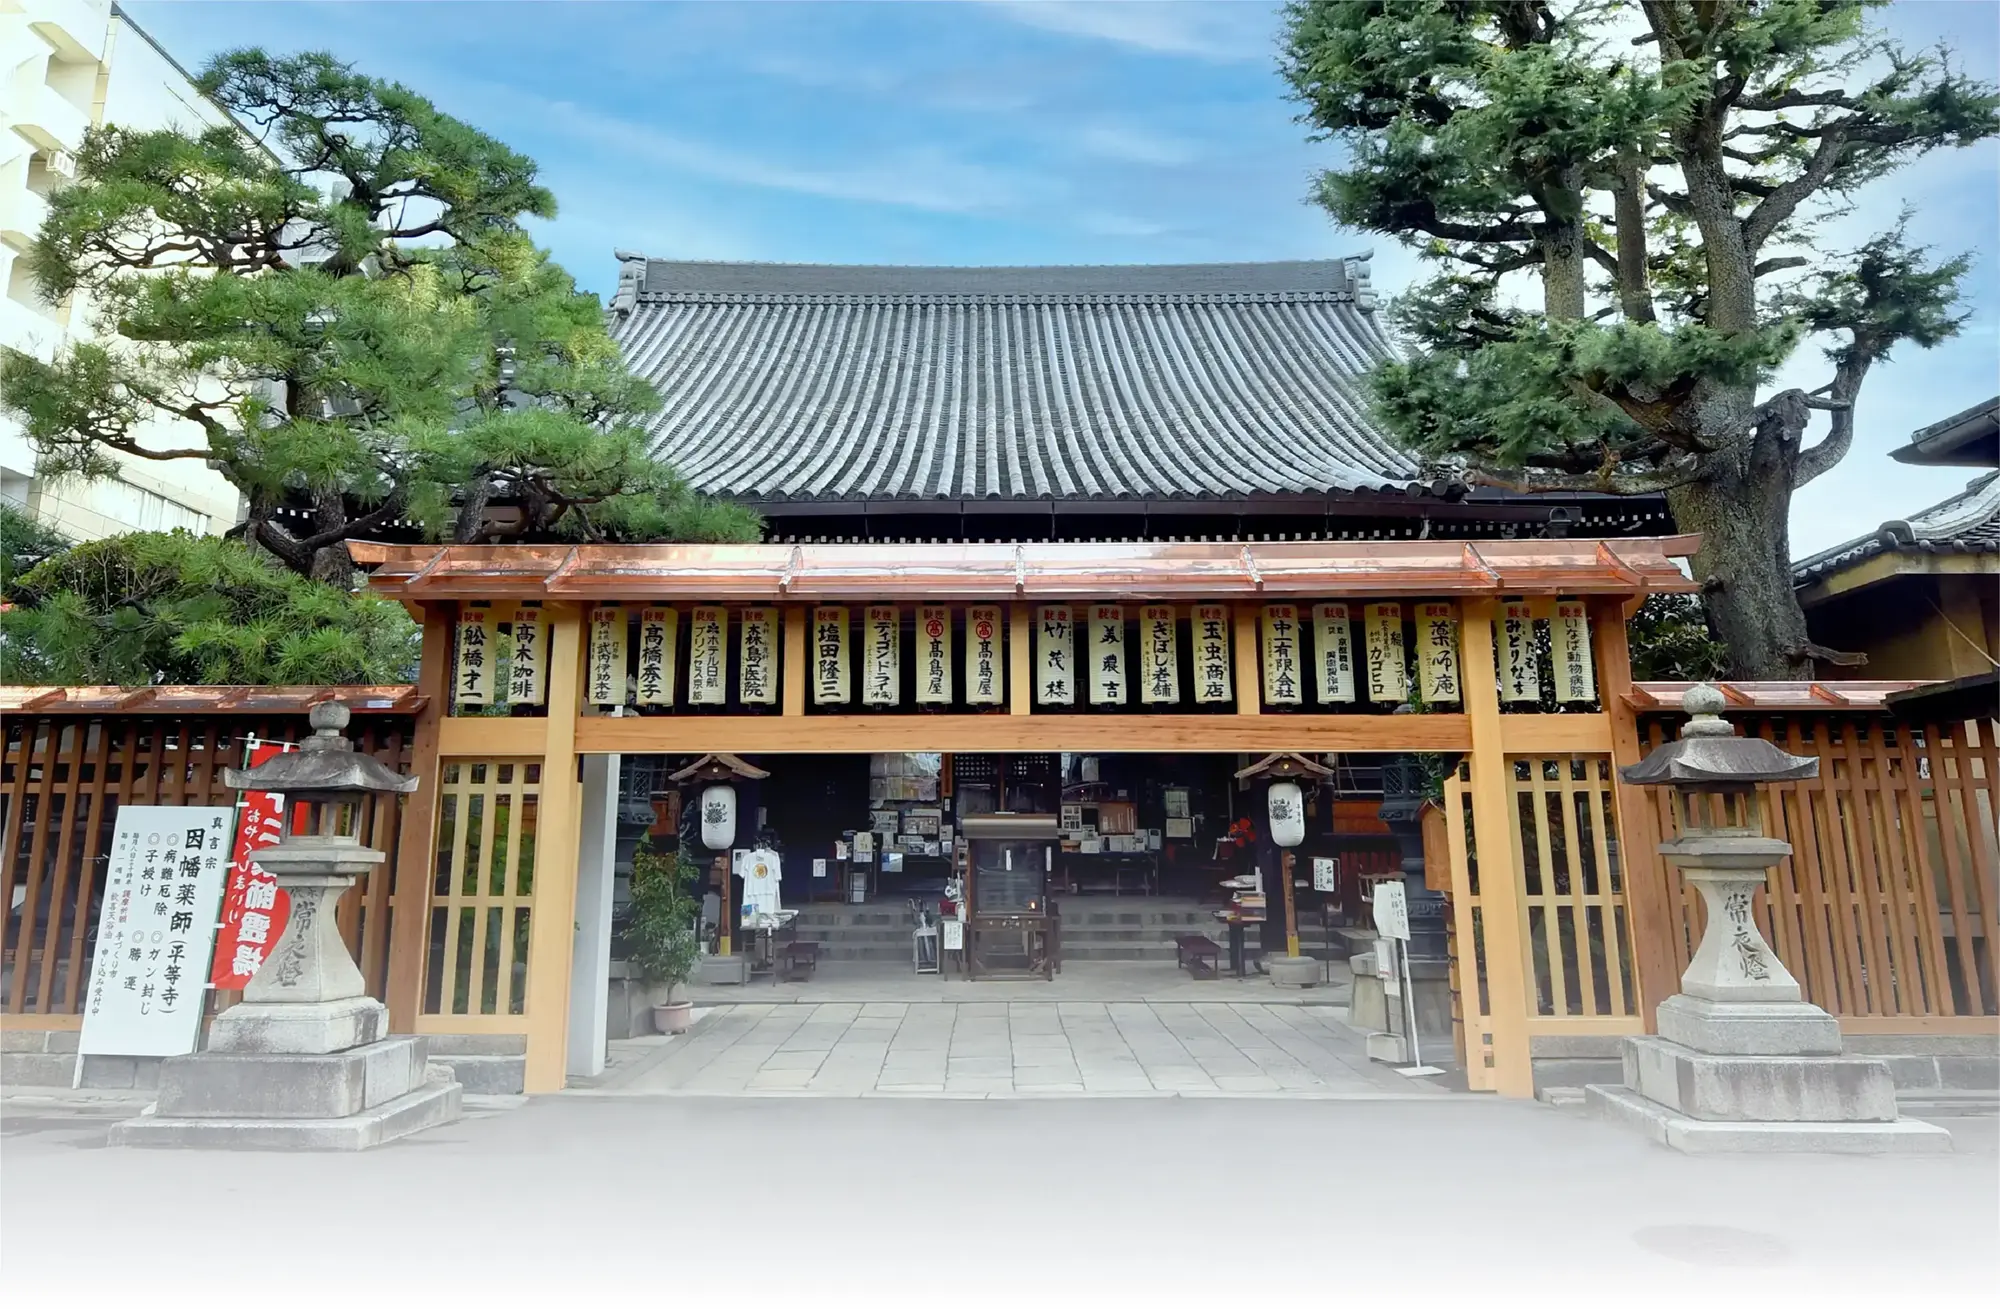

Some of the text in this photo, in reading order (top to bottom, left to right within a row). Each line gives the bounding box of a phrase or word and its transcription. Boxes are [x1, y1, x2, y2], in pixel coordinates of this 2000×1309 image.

[692, 625, 706, 700] プリンセス京都
[706, 636, 719, 687] ホテル日航
[743, 624, 764, 698] 森島医院
[817, 623, 841, 697] 塩田隆三
[1099, 625, 1120, 697] 美濃吉
[1202, 621, 1224, 697] 玉虫商店
[1273, 620, 1296, 698] 中一有限会社
[1370, 646, 1384, 694] カゴヒロ
[1565, 618, 1585, 697] いなば動物病院
[205, 817, 222, 869] 真言宗
[124, 849, 158, 990] 子授け 勝運
[141, 849, 177, 1015] 病難厄除 ガン封じ
